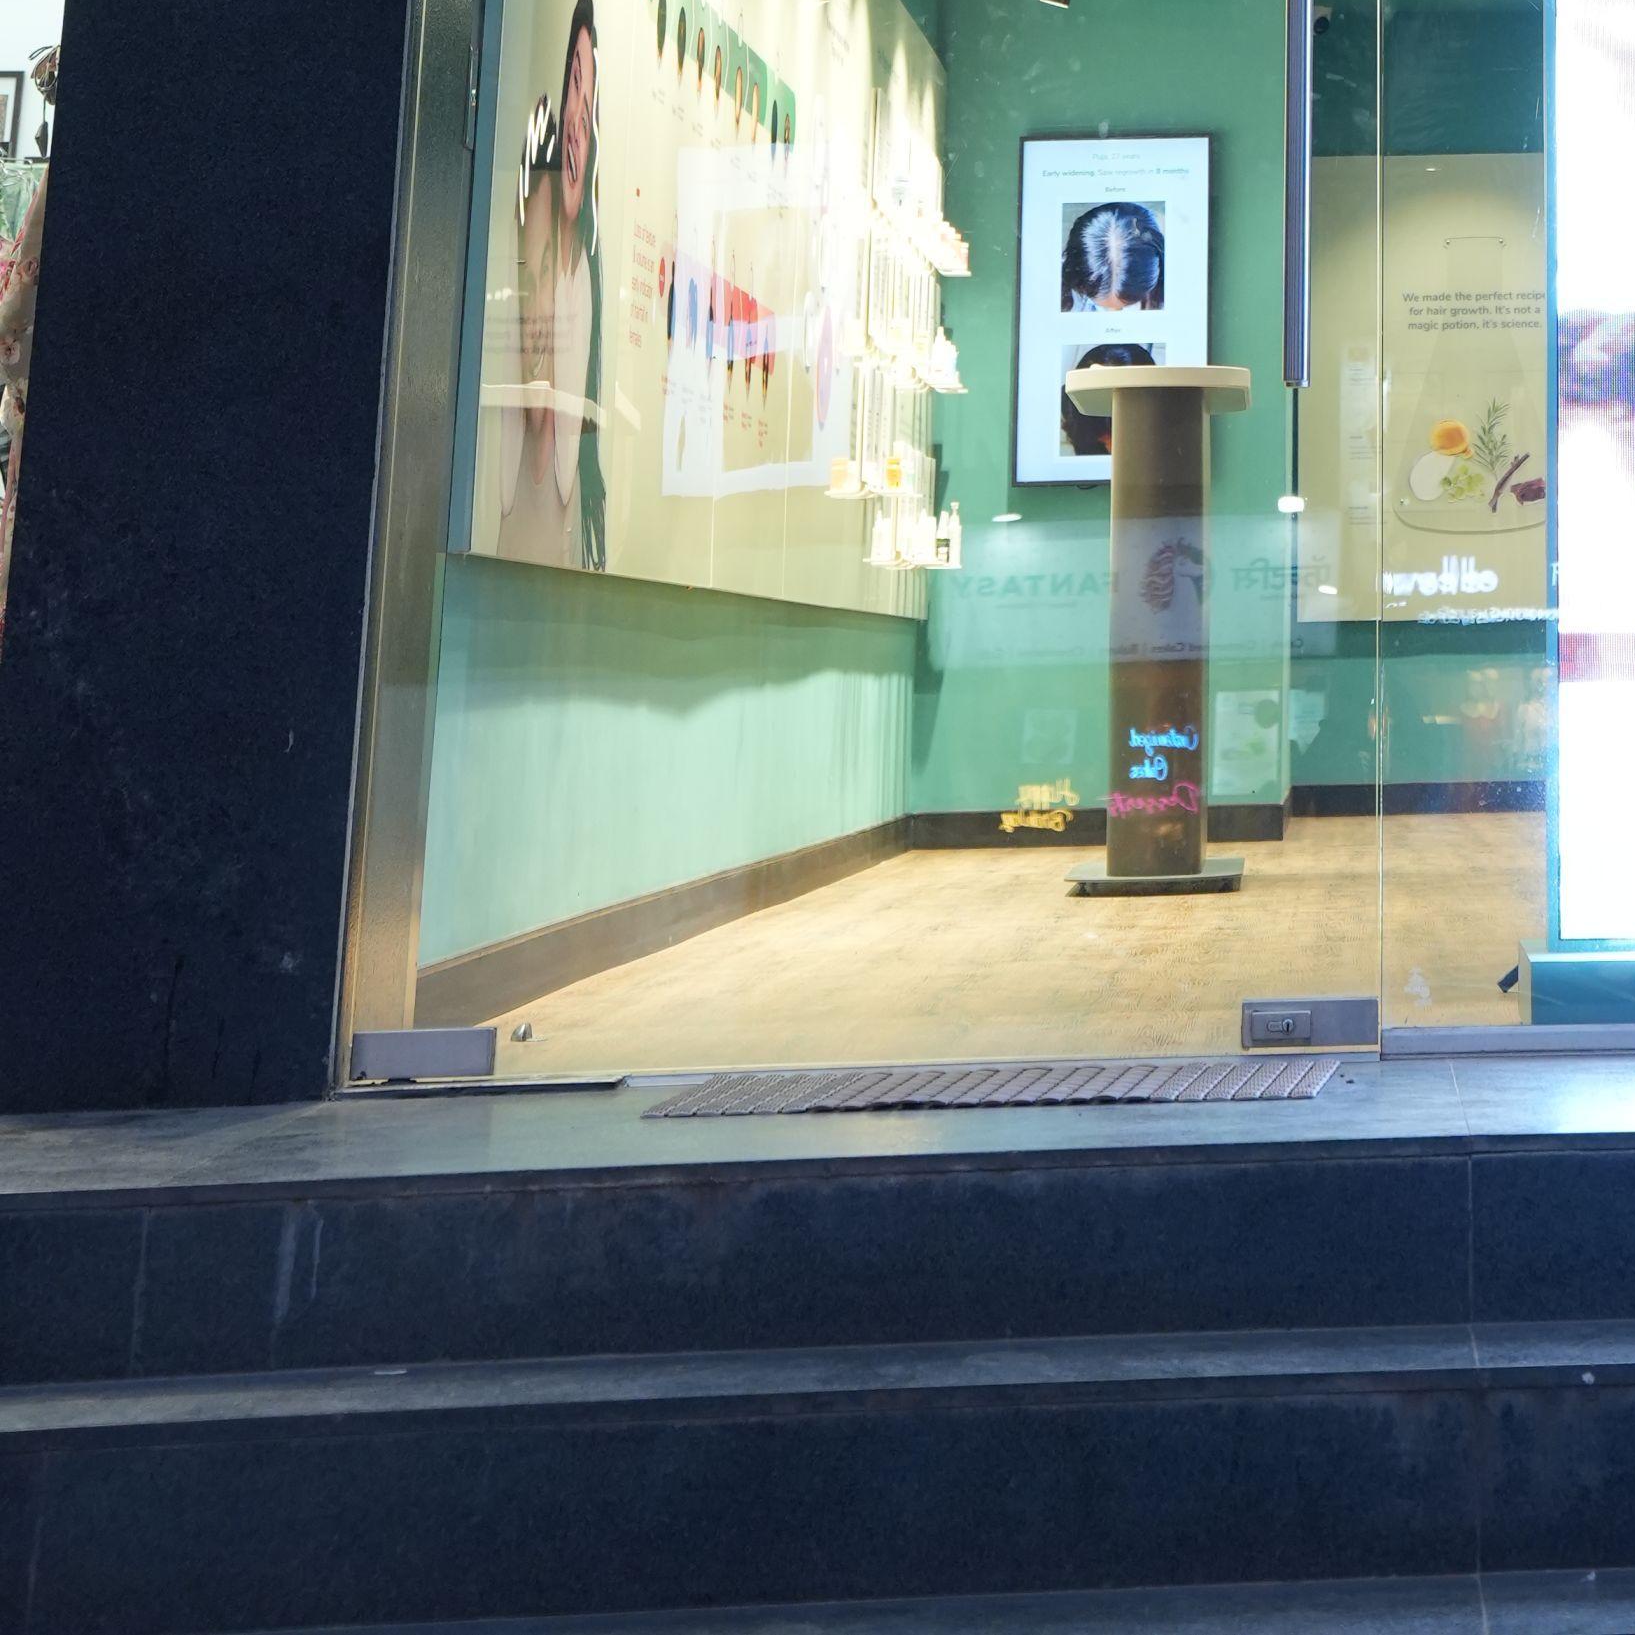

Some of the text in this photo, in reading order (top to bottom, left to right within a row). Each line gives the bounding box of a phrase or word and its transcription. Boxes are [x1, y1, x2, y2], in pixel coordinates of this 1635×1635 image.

[1402, 292, 1420, 303] We
[1422, 292, 1452, 302] made
[1455, 291, 1473, 301] the
[1475, 290, 1513, 302] perfect
[1409, 306, 1424, 316] for
[1426, 305, 1448, 316] hair
[1450, 304, 1492, 317] growth.
[1495, 304, 1511, 315] It's
[1514, 305, 1531, 315] not
[1408, 319, 1542, 332] magic potion, it's science.
